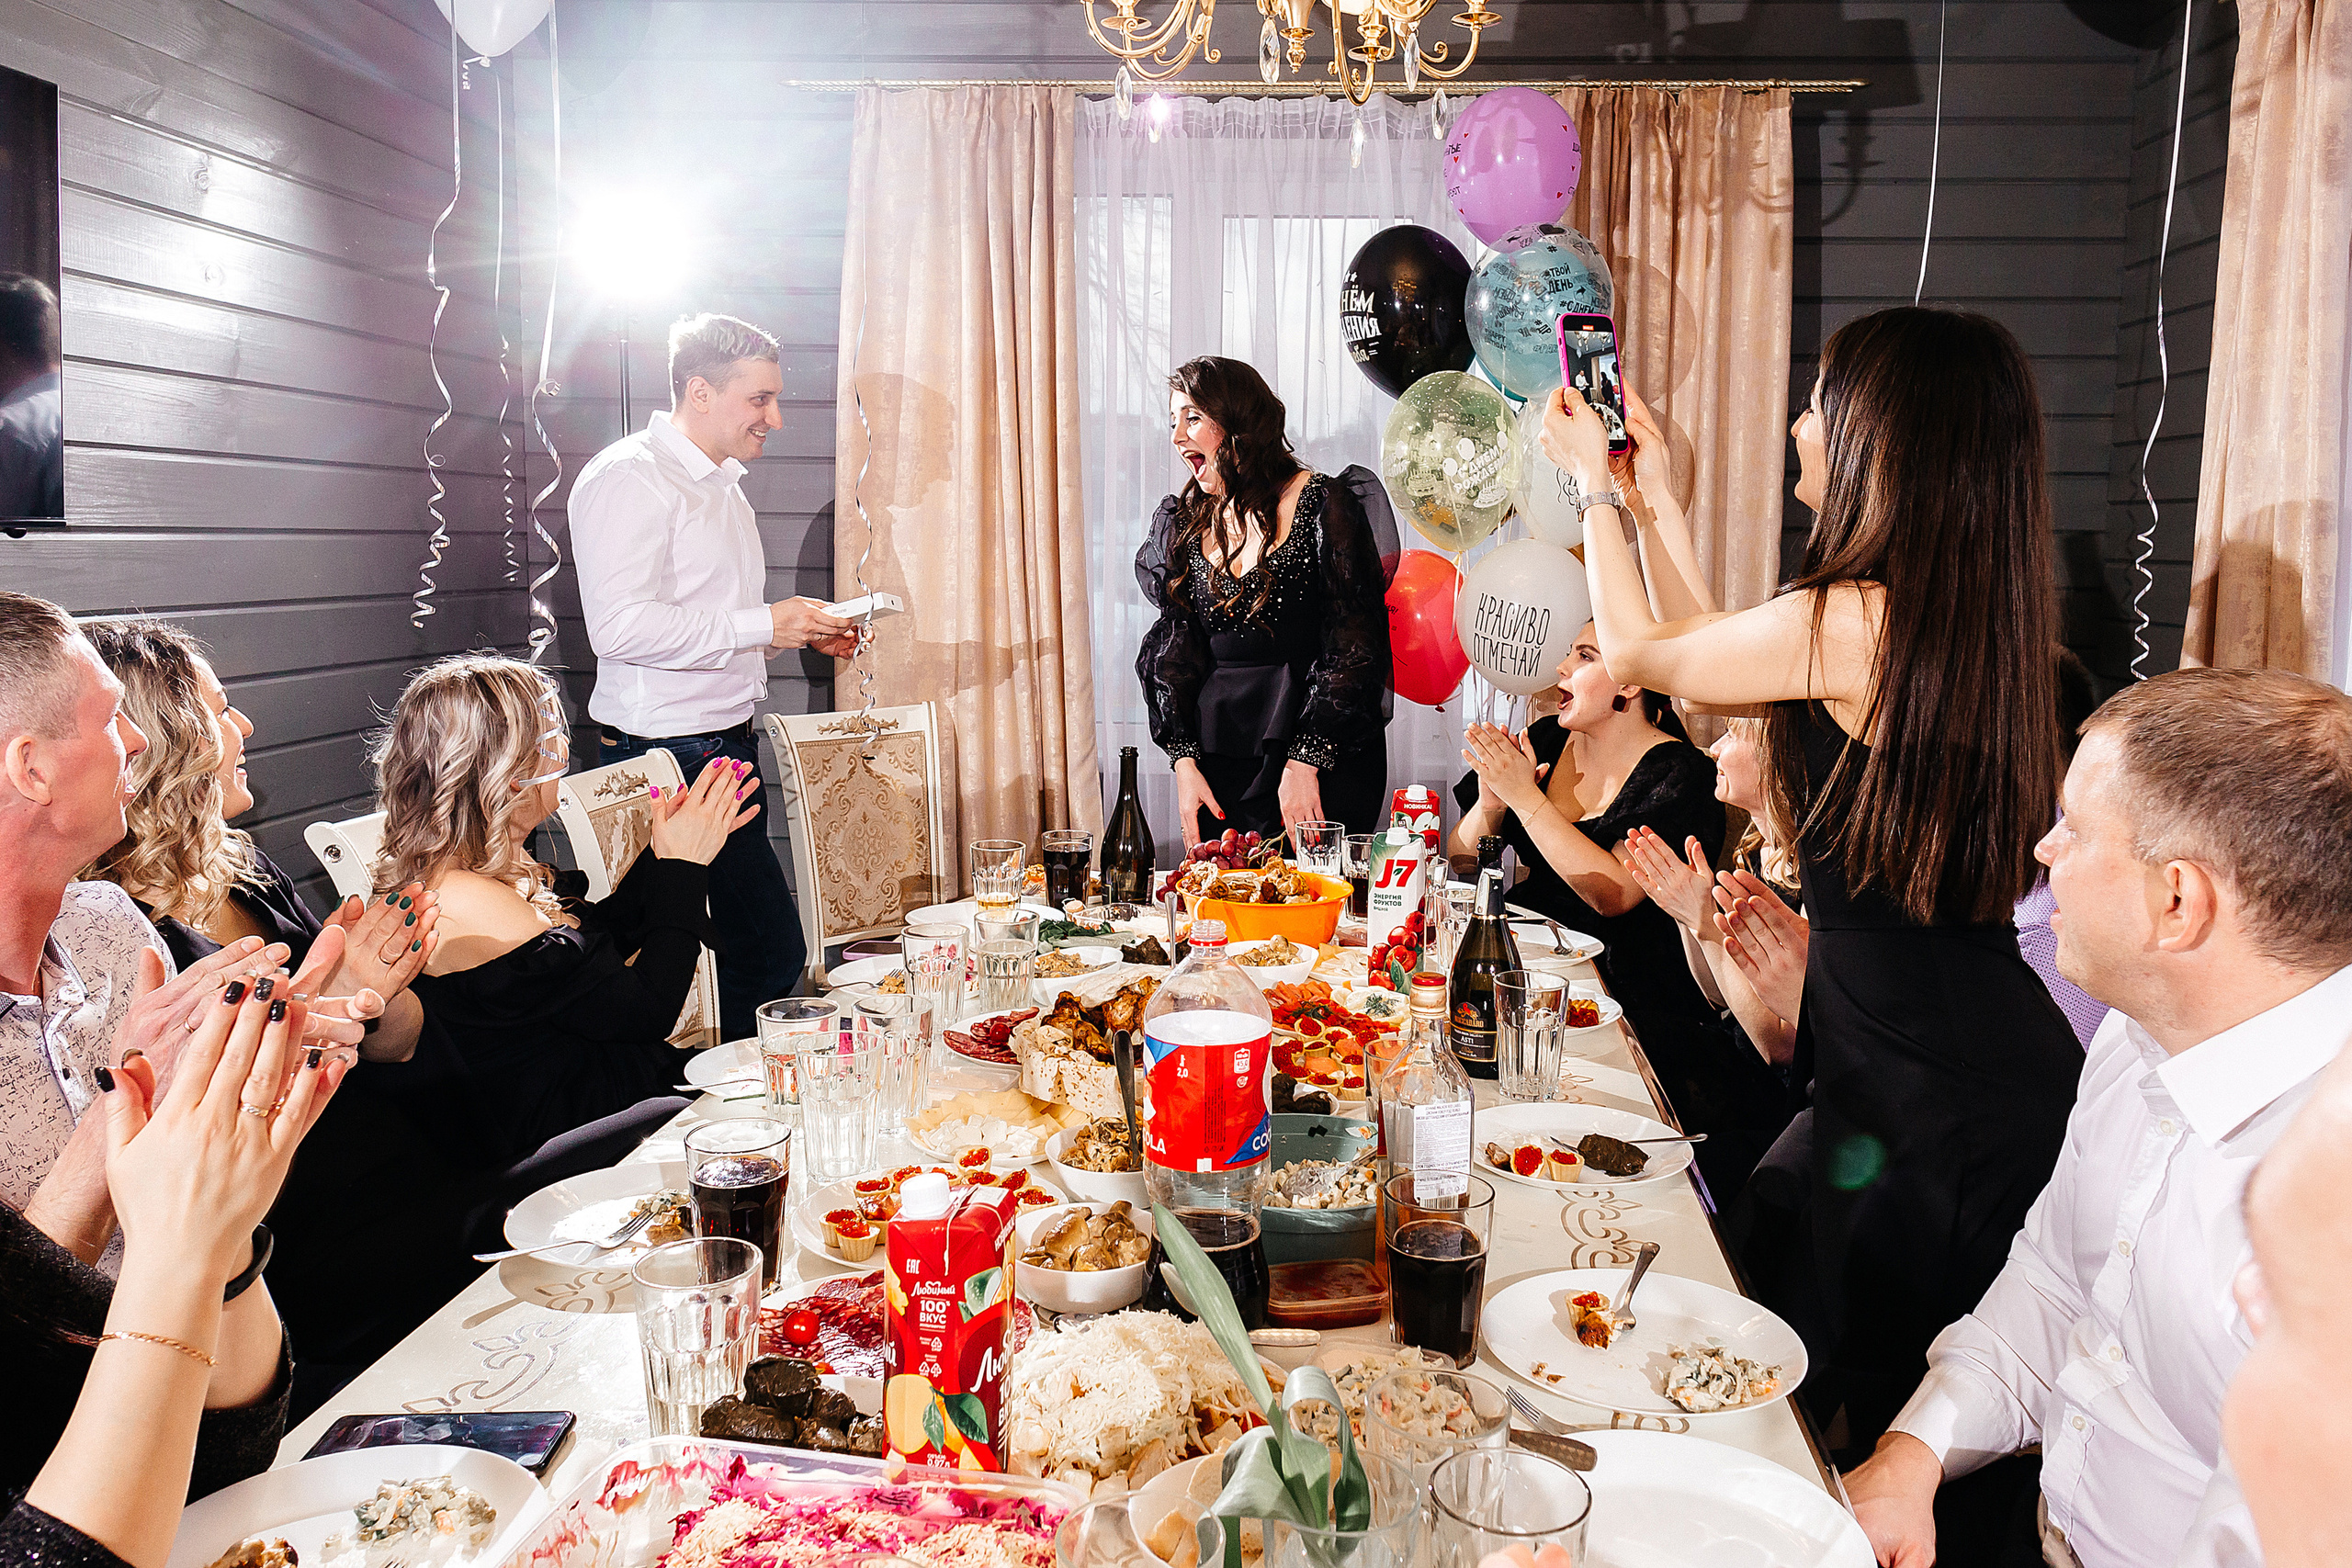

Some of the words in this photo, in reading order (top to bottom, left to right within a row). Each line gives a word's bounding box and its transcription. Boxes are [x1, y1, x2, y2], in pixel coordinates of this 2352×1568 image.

[1549, 262, 1571, 277] ТВОЙ
[1547, 278, 1574, 295] ДЕНЬ
[1341, 285, 1374, 313] НЁМ
[1475, 592, 1551, 646] КРАСИВО
[1473, 632, 1542, 678] ОТМЕЧАЙ
[1374, 859, 1419, 888] J7
[1373, 892, 1402, 901] ЭНЕРГИЯ
[1461, 1035, 1475, 1044] ASTI
[1177, 1066, 1189, 1078] 2,0
[910, 1280, 956, 1297] Любимый
[920, 1312, 947, 1325] ВКУС
